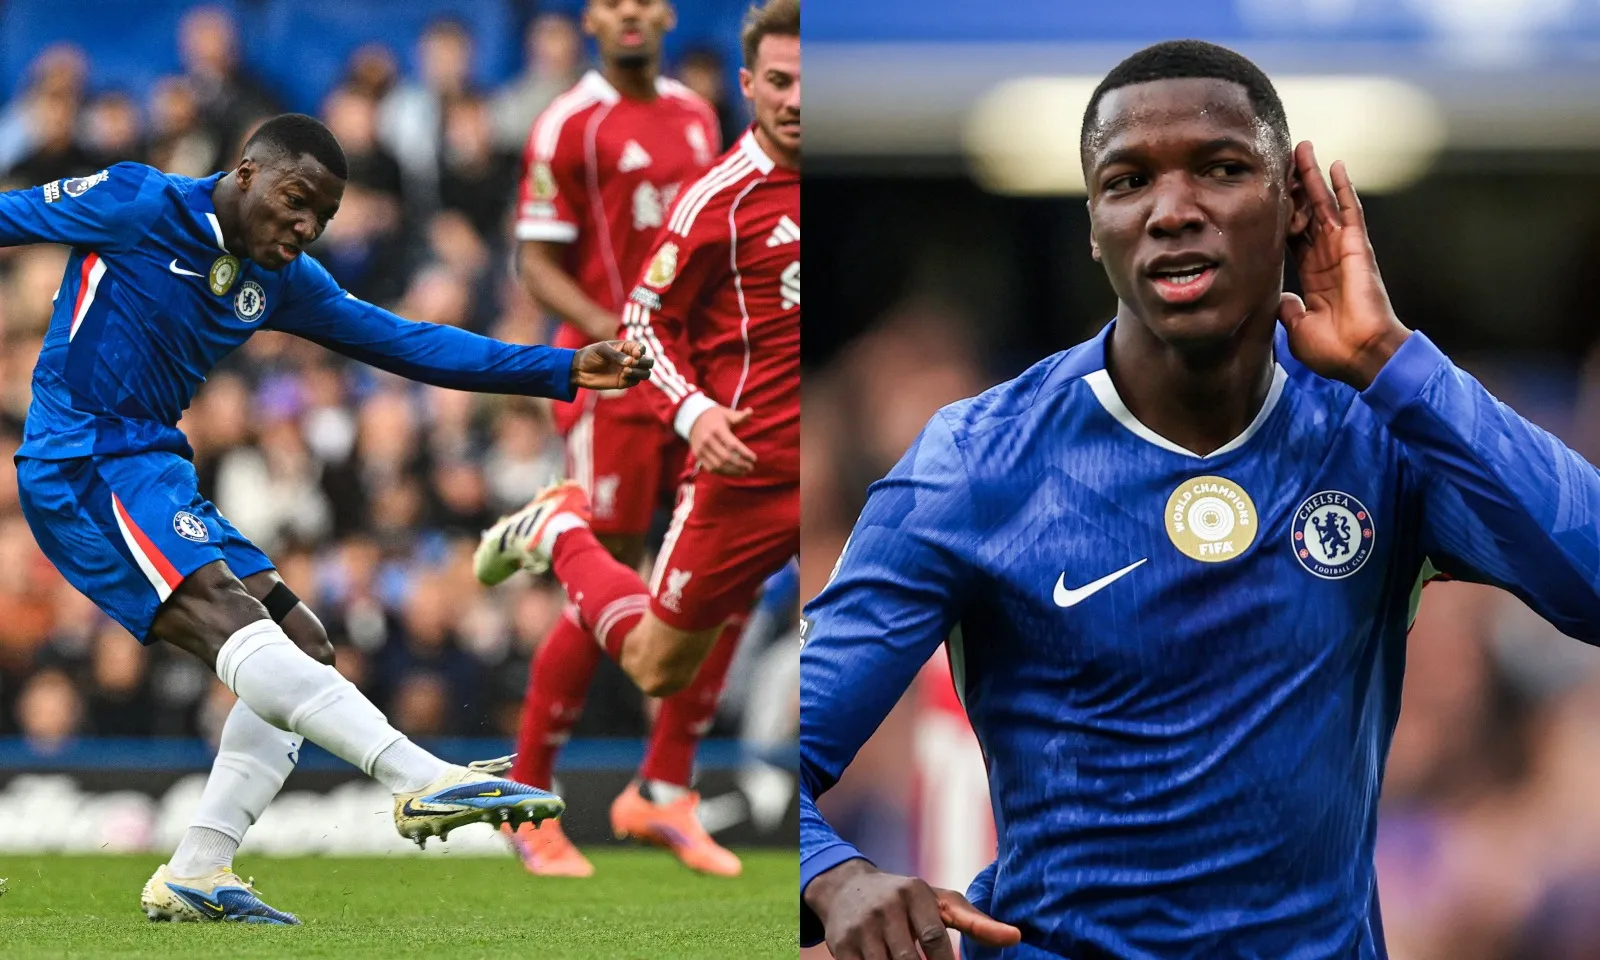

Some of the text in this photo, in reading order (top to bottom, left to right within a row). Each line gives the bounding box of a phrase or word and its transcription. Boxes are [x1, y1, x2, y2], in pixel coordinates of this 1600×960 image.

[1173, 483, 1249, 533] WORLD CHAMPIONS
[1299, 493, 1349, 520] CHELSEA
[1199, 541, 1234, 556] FIFA
[1314, 549, 1366, 575] FOOTBALL CLUB
